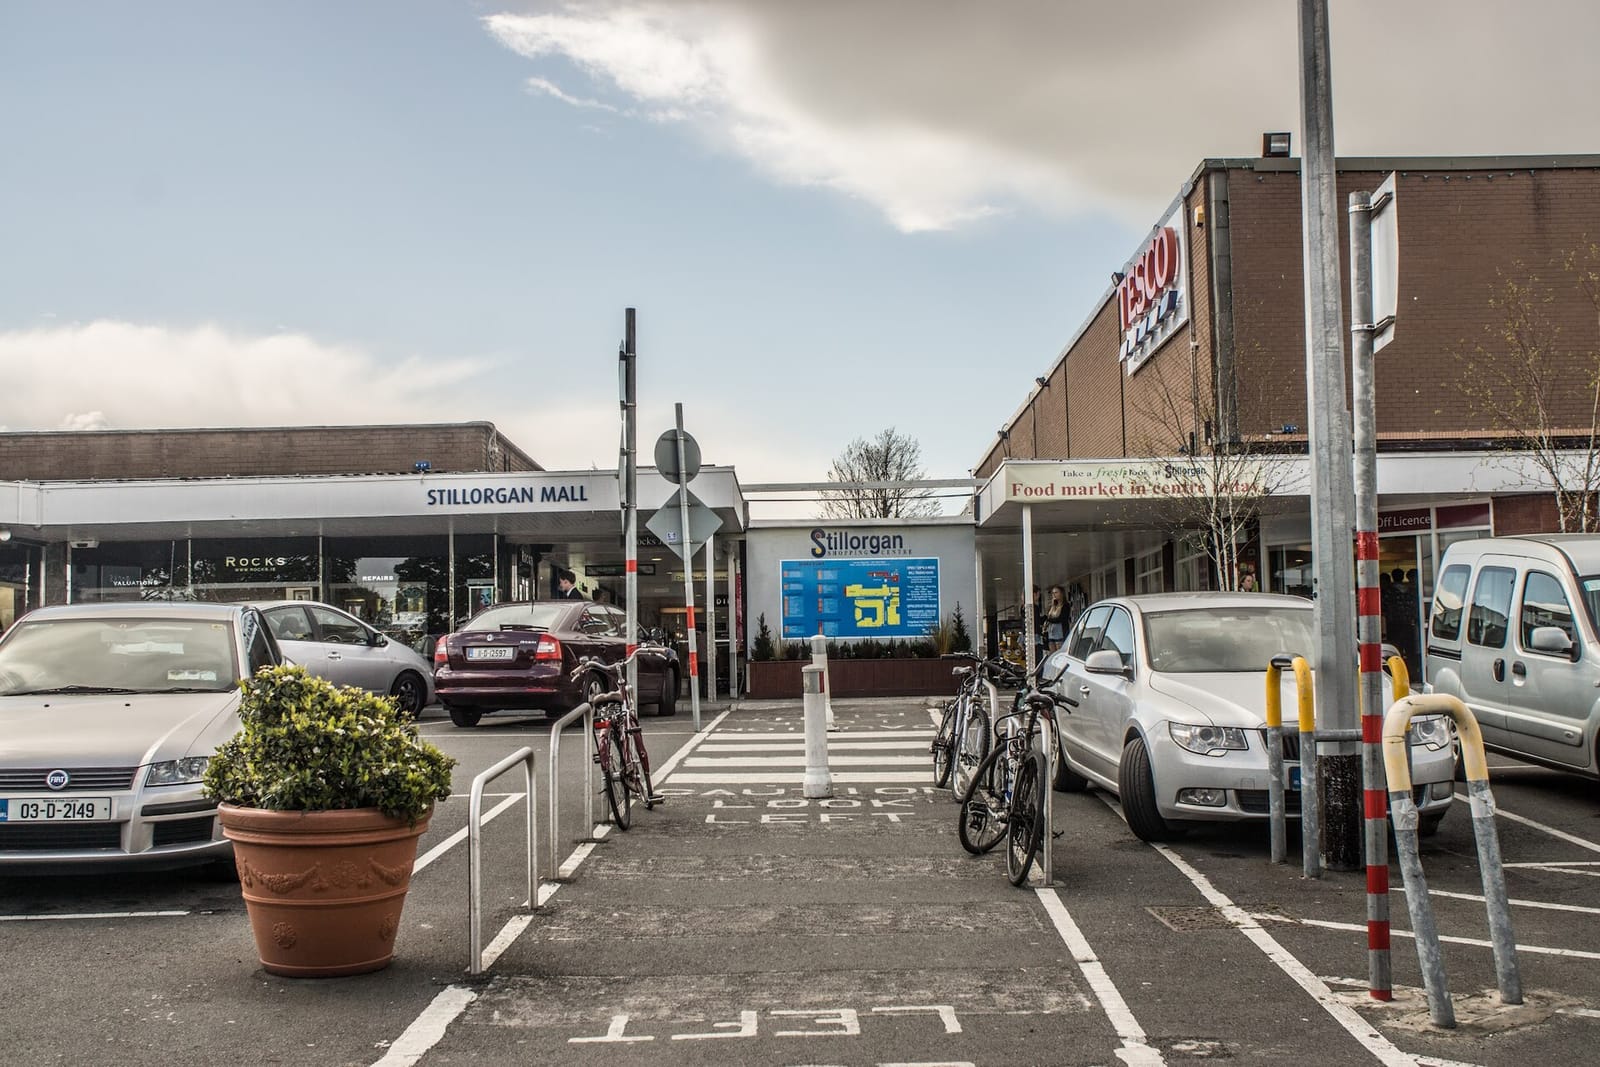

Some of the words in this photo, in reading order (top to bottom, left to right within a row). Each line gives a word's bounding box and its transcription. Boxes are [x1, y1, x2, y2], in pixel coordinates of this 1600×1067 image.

[1116, 227, 1179, 332] TESCO
[427, 487, 533, 505] STILLORGAN
[540, 485, 588, 502] MALL
[1012, 483, 1055, 497] Food
[1061, 482, 1124, 497] market
[1130, 481, 1146, 495] in
[1152, 480, 1206, 496] centre
[1393, 515, 1431, 527] Licence
[811, 528, 903, 558] Stillorgan
[21, 803, 95, 819] 03-D-2149
[713, 799, 914, 808] LOOK
[705, 813, 915, 824] LEFT
[567, 1005, 962, 1043] LEFT
